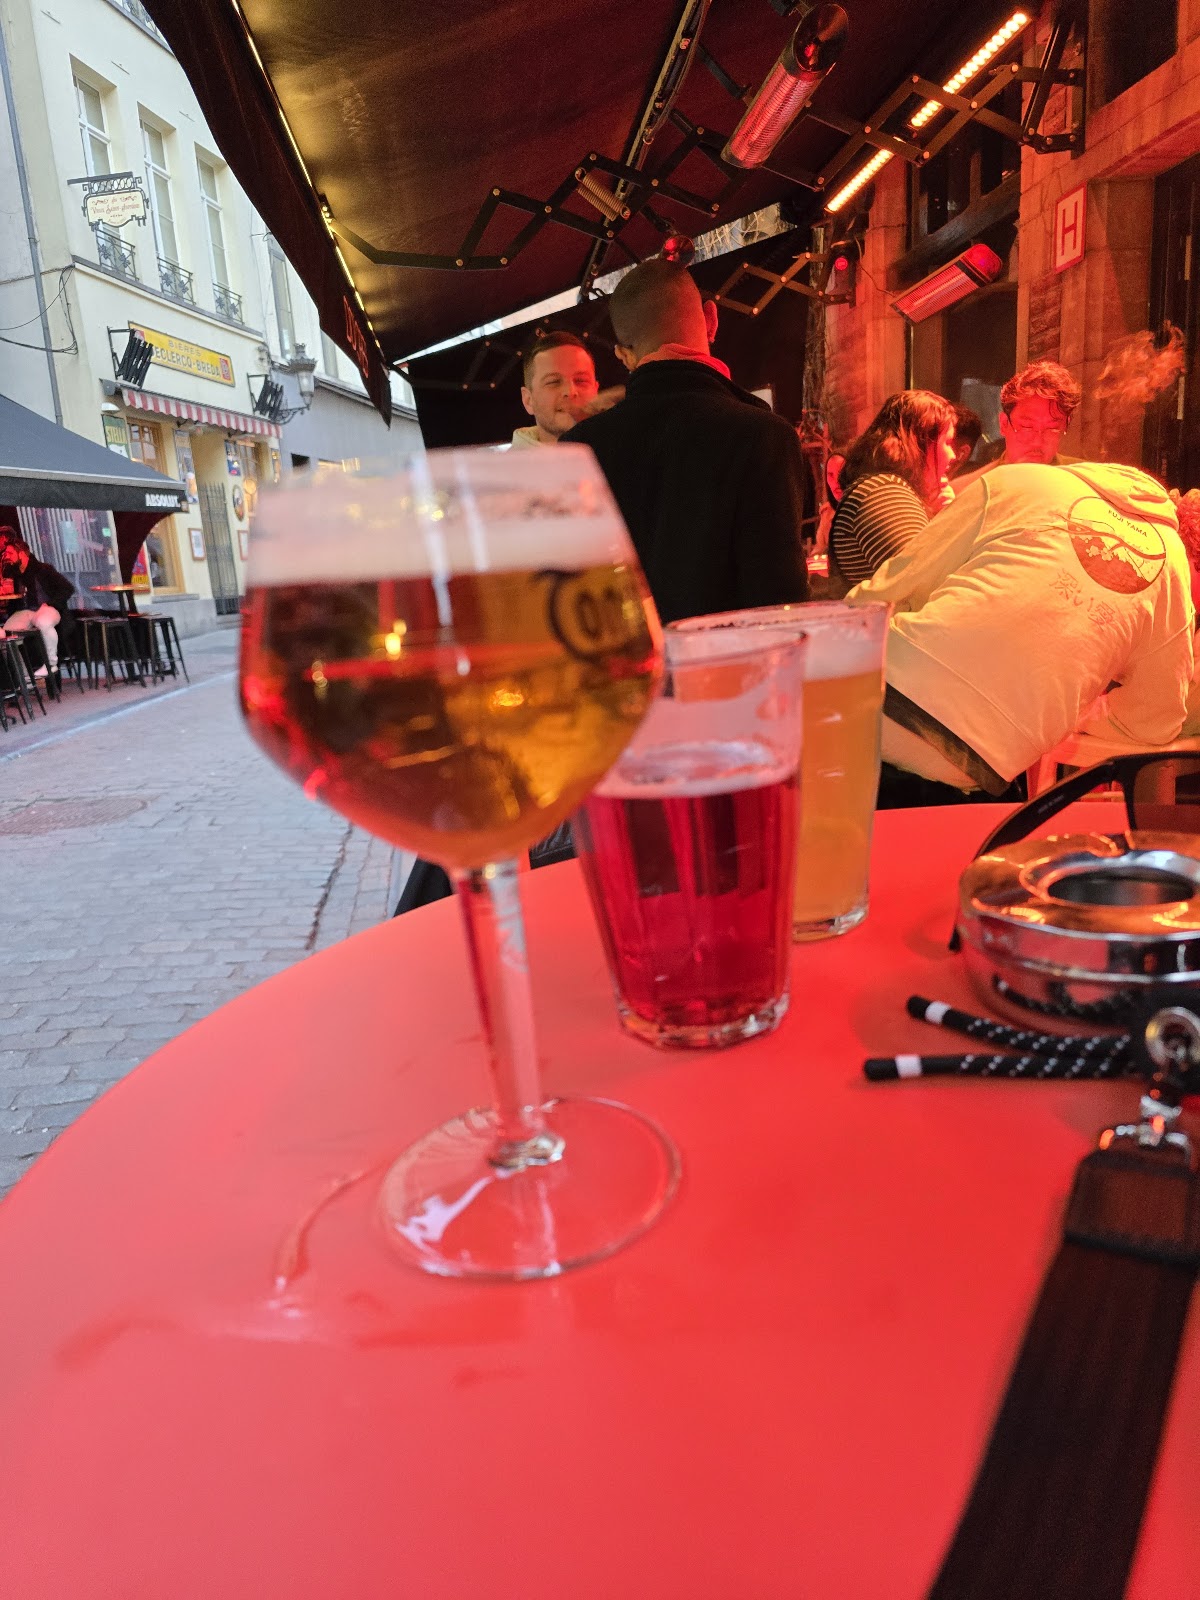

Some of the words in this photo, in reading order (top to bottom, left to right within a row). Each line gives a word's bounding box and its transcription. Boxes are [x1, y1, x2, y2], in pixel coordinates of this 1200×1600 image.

[1061, 201, 1078, 256] H
[151, 346, 220, 376] ECLERCQ-BREDA
[1127, 520, 1147, 537] YAMA
